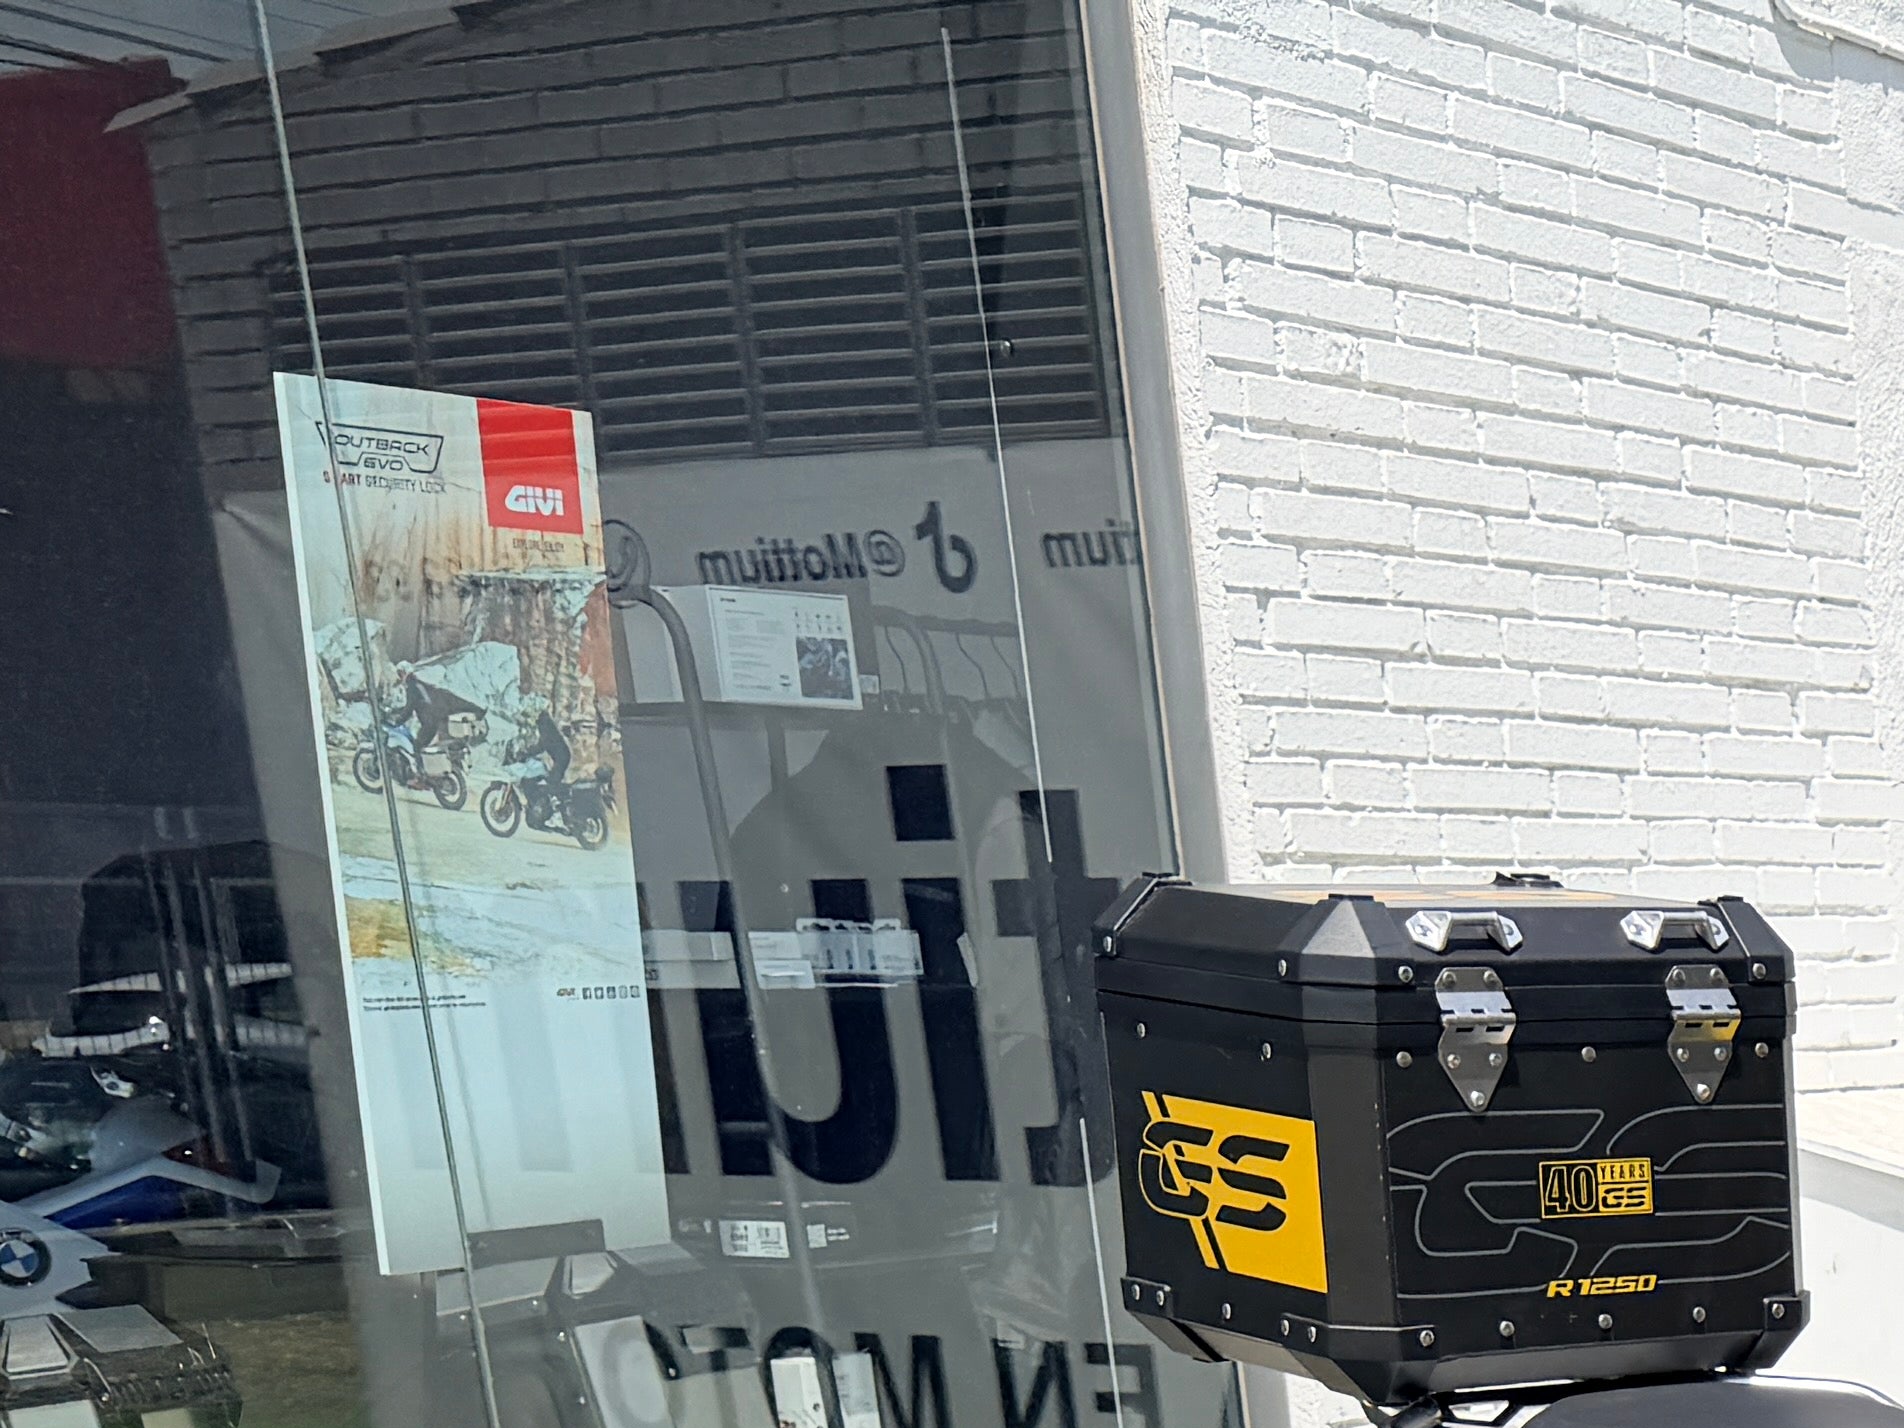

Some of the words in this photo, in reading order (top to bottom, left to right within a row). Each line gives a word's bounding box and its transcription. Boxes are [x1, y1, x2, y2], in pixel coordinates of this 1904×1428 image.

[334, 433, 430, 456] OUTBACK
[363, 457, 405, 471] EVO
[323, 470, 361, 486] SART
[505, 485, 565, 516] GIVI
[1138, 1120, 1290, 1232] GS
[1545, 1165, 1597, 1212] 40
[1600, 1163, 1645, 1181] YEARS
[1601, 1186, 1647, 1209] GS
[1546, 1279, 1574, 1298] R
[1578, 1274, 1657, 1296] 1250
